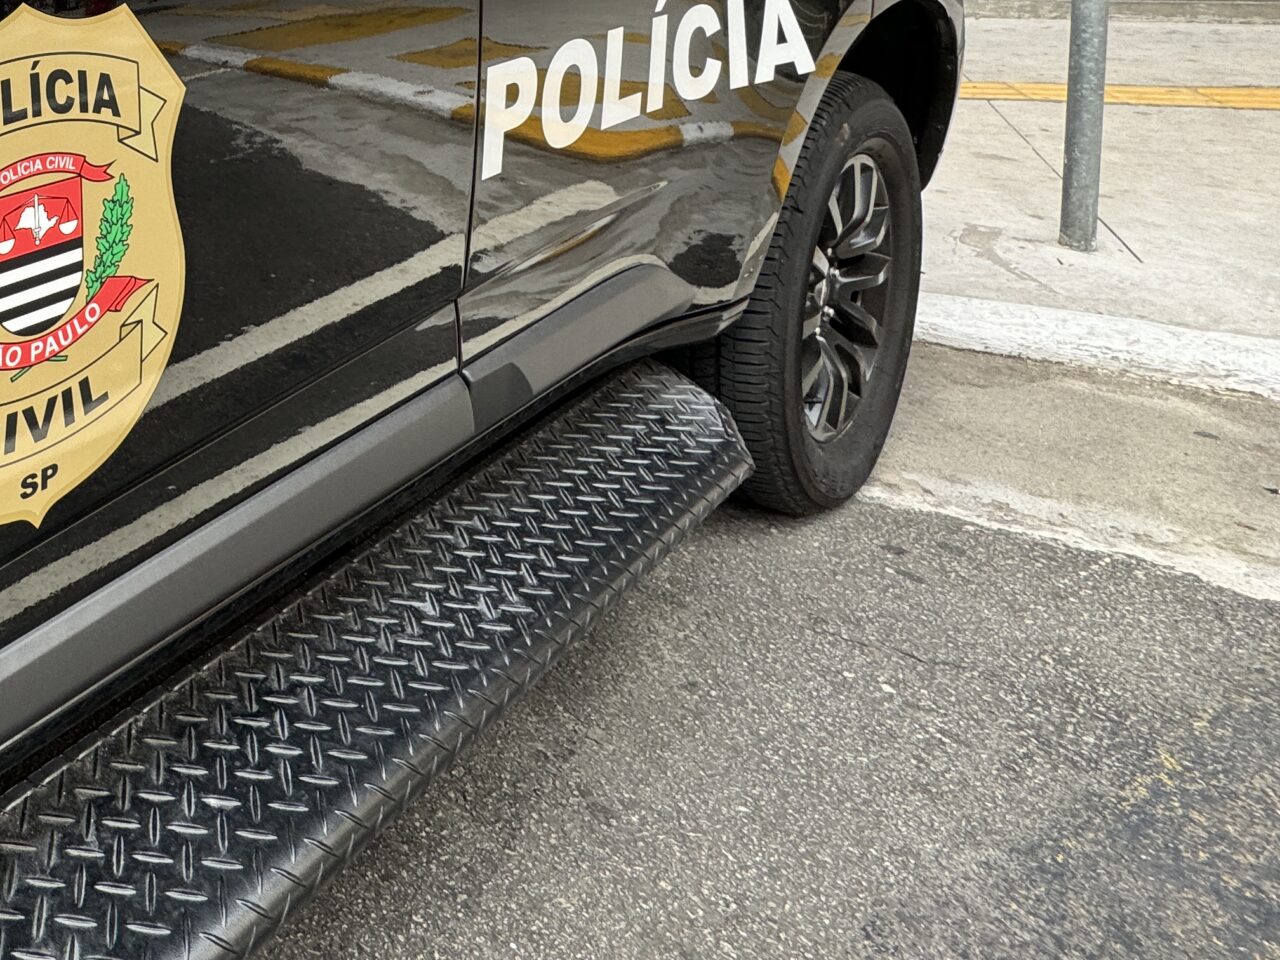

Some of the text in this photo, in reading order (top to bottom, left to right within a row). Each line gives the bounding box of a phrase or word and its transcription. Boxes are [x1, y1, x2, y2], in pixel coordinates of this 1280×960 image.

[46, 156, 76, 170] CIVIL
[31, 303, 100, 363] PAULO
[20, 463, 59, 500] SP
